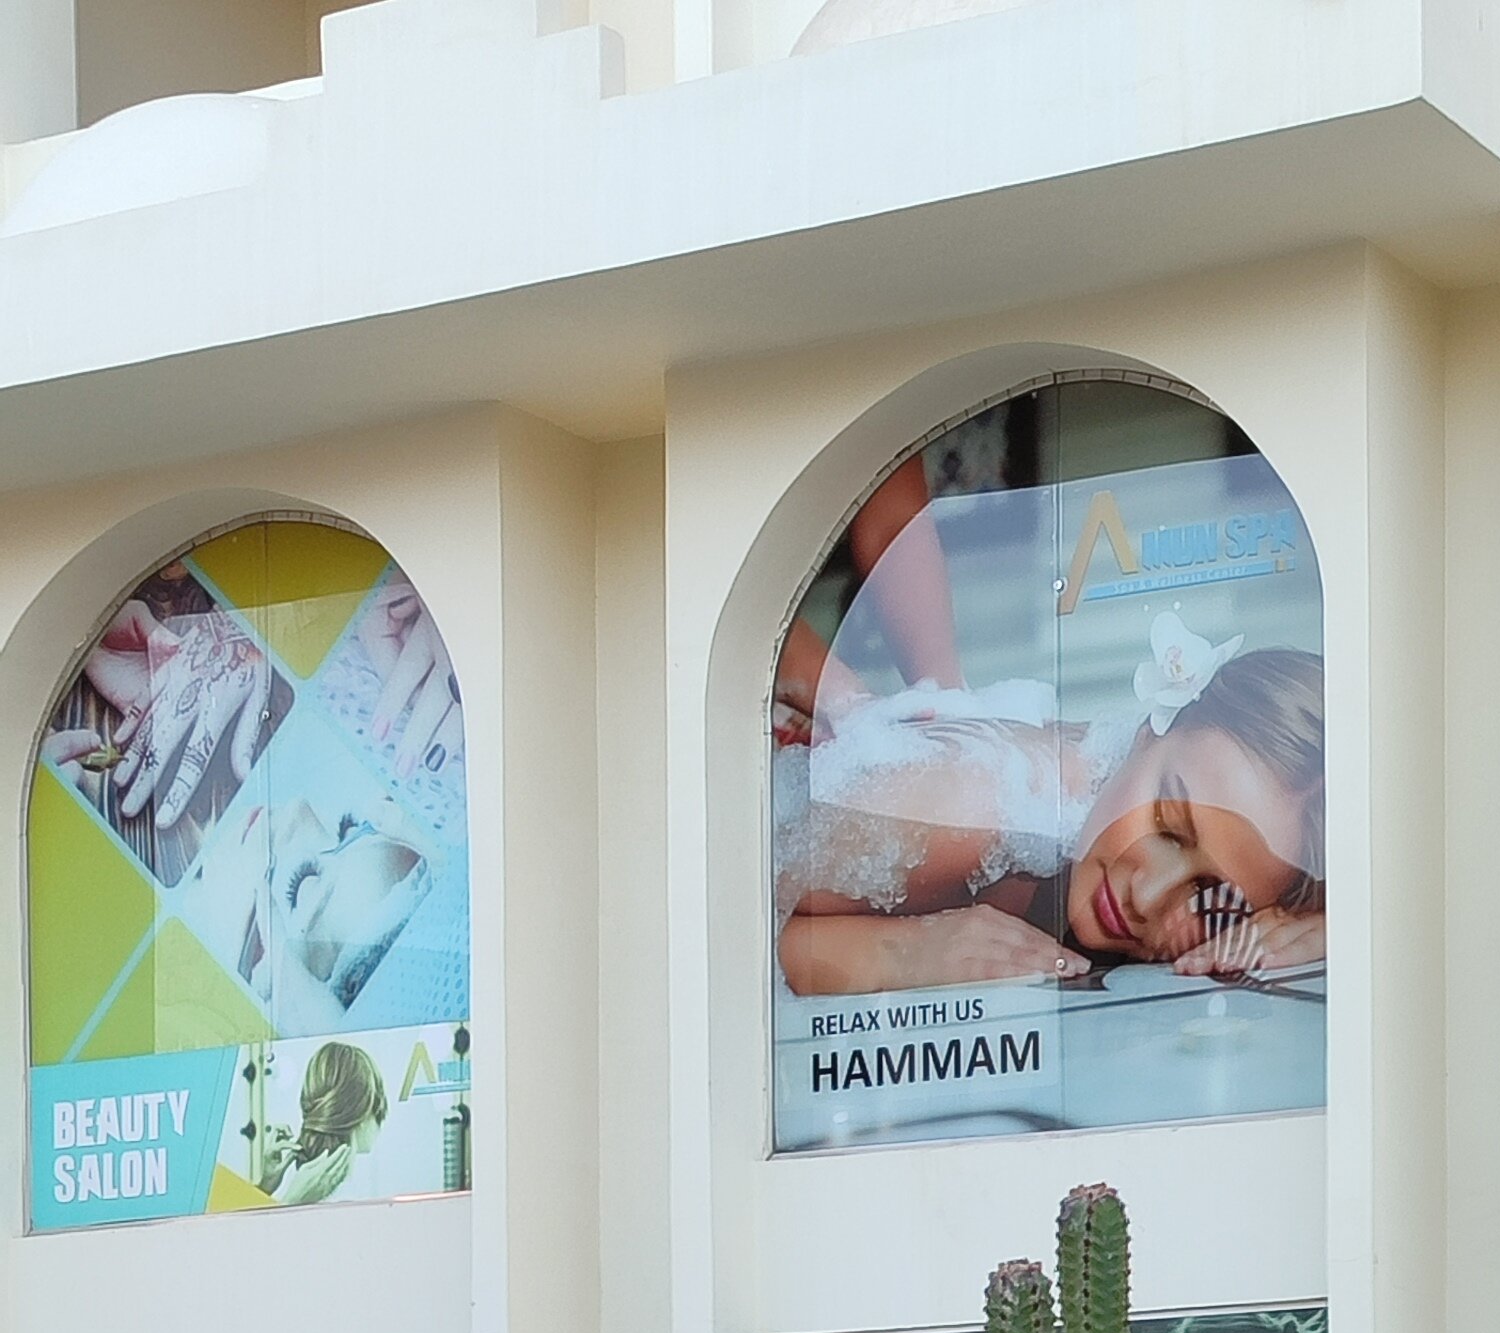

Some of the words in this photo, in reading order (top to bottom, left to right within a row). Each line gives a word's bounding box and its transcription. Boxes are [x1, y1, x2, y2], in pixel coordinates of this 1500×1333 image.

[1224, 508, 1297, 560] SPA
[811, 1009, 881, 1037] RELAX
[887, 1001, 948, 1030] WITH
[955, 998, 985, 1021] US
[811, 1030, 1041, 1092] HAMMAM
[53, 1089, 191, 1150] BEAUTY
[53, 1145, 168, 1203] SALON
